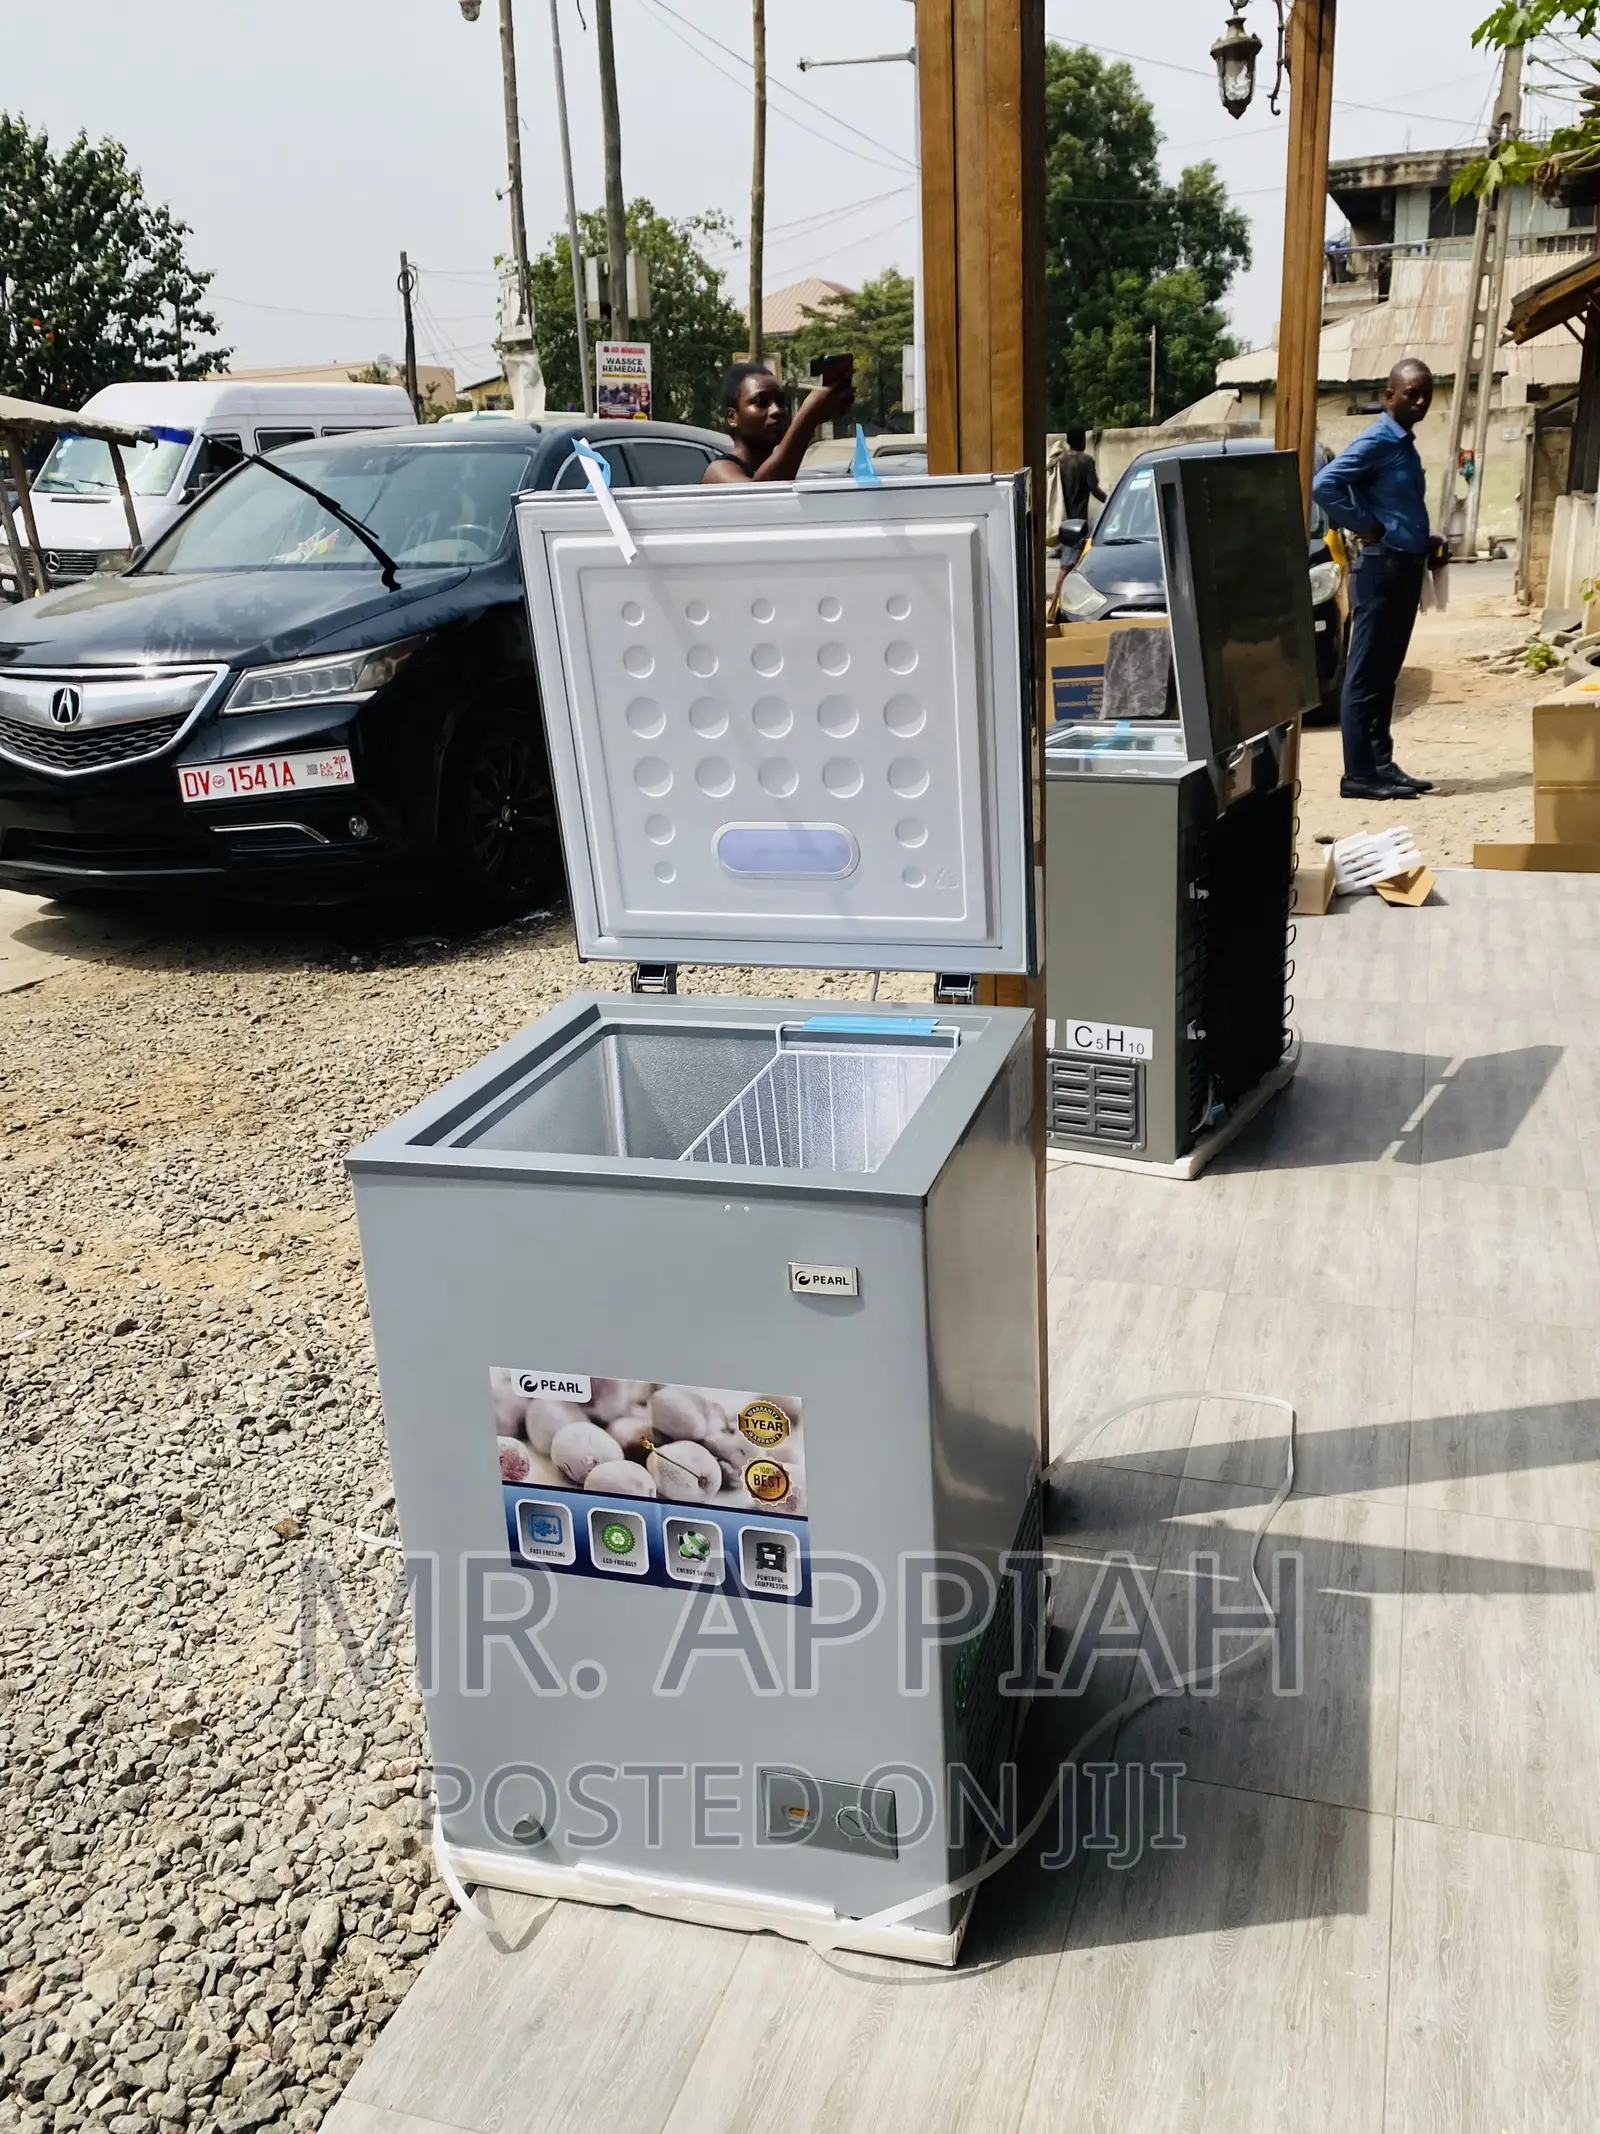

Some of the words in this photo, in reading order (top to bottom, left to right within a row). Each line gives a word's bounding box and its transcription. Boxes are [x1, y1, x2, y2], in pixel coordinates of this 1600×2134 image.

[606, 357, 643, 366] WASSCE
[602, 365, 647, 374] REMEDIAL
[184, 770, 210, 797] DV
[227, 761, 296, 793] 1541A
[812, 1274, 850, 1286] PEARL
[540, 1379, 584, 1394] PEARL
[747, 1406, 779, 1421] WARRANTY
[751, 1418, 784, 1433] YEAR
[753, 1473, 782, 1488] BEST
[676, 1567, 697, 1576] ENERGY
[756, 1573, 785, 1584] POWERFUL
[754, 1581, 789, 1591] COMPRESSOR
